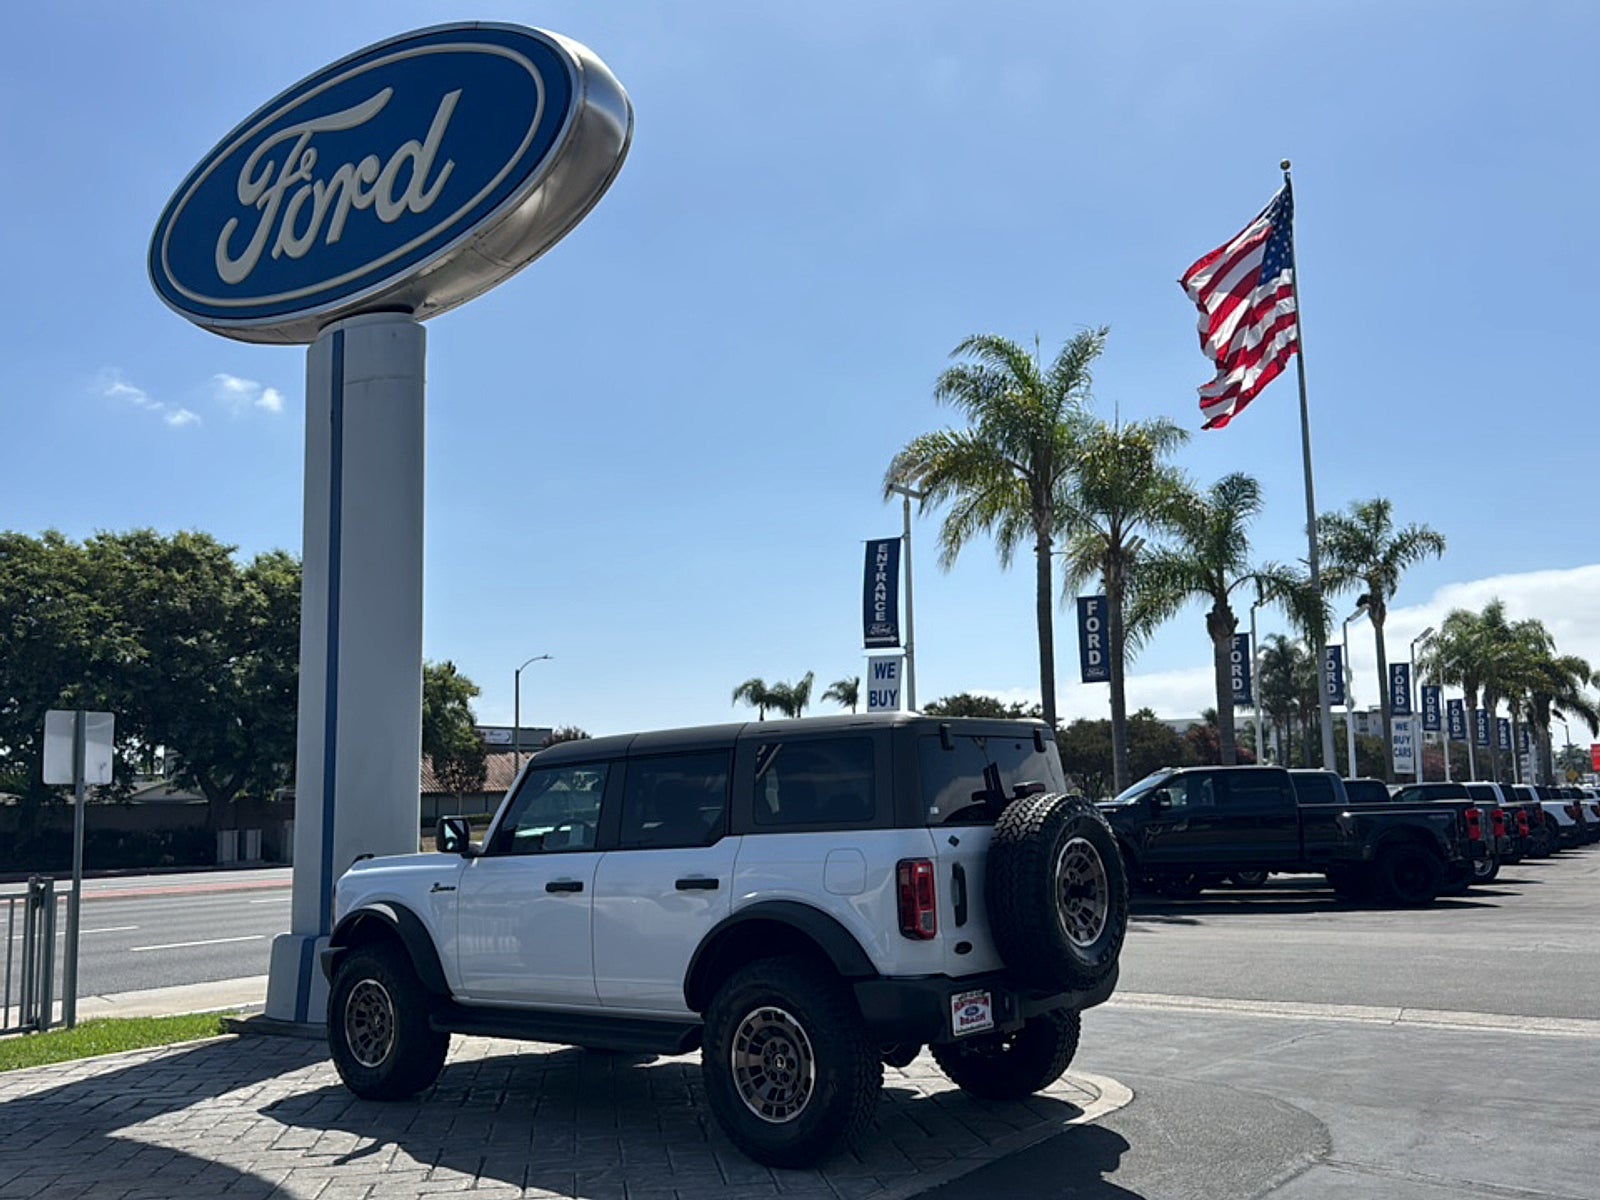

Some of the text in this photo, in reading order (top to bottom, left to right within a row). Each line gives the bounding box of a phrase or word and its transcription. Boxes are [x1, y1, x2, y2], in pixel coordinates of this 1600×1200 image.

[215, 87, 463, 285] Ford
[874, 543, 889, 622] ENTRANCE
[1086, 600, 1101, 666] FORD
[874, 661, 896, 680] WE
[1230, 636, 1243, 690] FORD
[1325, 648, 1337, 694] FORD
[869, 689, 898, 708] BUY
[1394, 665, 1405, 706] FORD
[1426, 687, 1436, 723] FORD
[1451, 701, 1461, 732] FORD
[1393, 735, 1411, 745] BUY
[1395, 721, 1409, 731] WE
